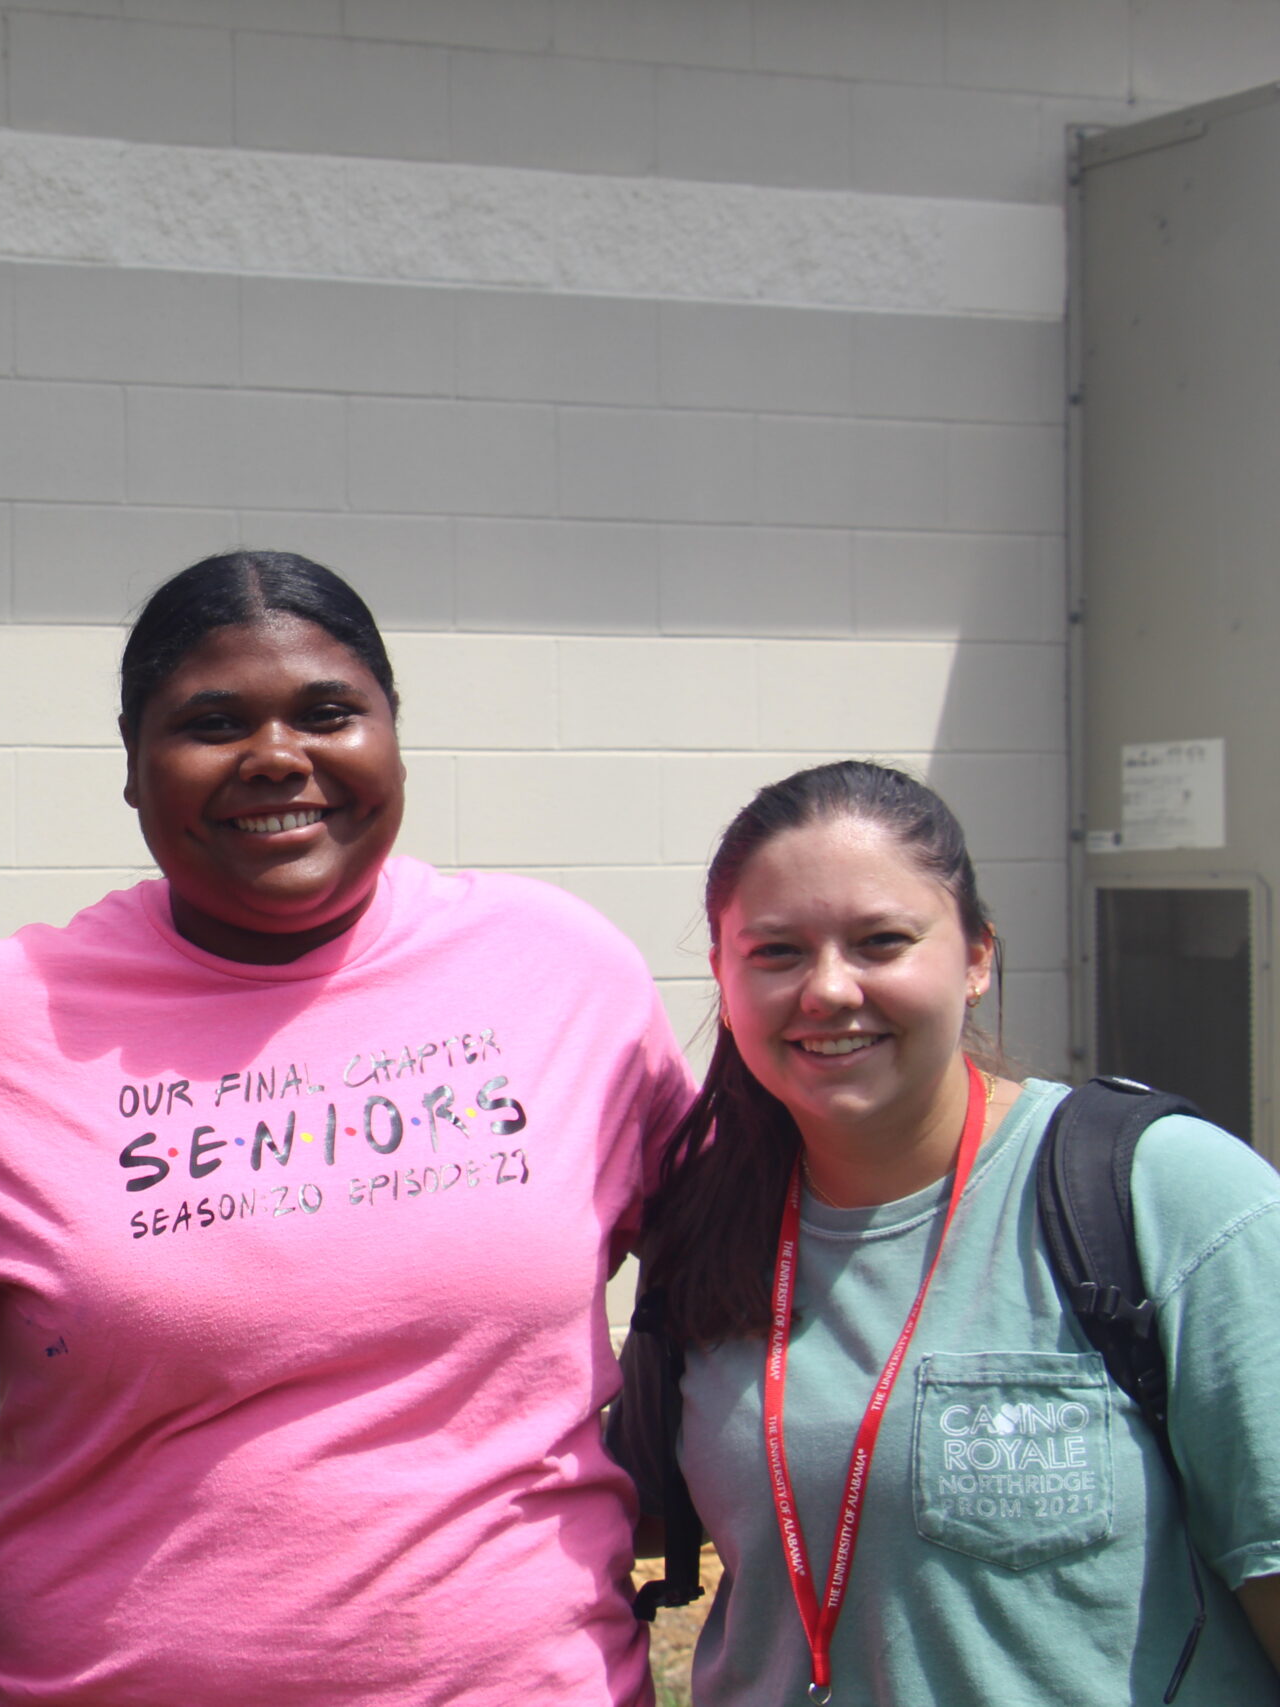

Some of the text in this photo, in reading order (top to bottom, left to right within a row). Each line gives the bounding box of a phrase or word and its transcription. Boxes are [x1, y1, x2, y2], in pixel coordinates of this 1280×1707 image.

[119, 1028, 501, 1118] OUR FINAL CHAPTER
[782, 1240, 794, 1258] THE
[775, 1260, 791, 1314] UNIVERSITY
[774, 1314, 785, 1328] OF
[871, 1391, 887, 1411] THE
[768, 1416, 778, 1434] THE
[939, 1402, 1090, 1437] CAINO
[943, 1436, 1088, 1471] ROYALE
[769, 1437, 788, 1499] UNIVERSITY
[937, 1470, 1096, 1495] NORTHRIDGE
[779, 1500, 792, 1516] OF
[843, 1509, 857, 1524] OF
[941, 1493, 1094, 1518] PROM 2021
[832, 1526, 854, 1587] UNIVERSITY
[827, 1588, 843, 1609] THE
